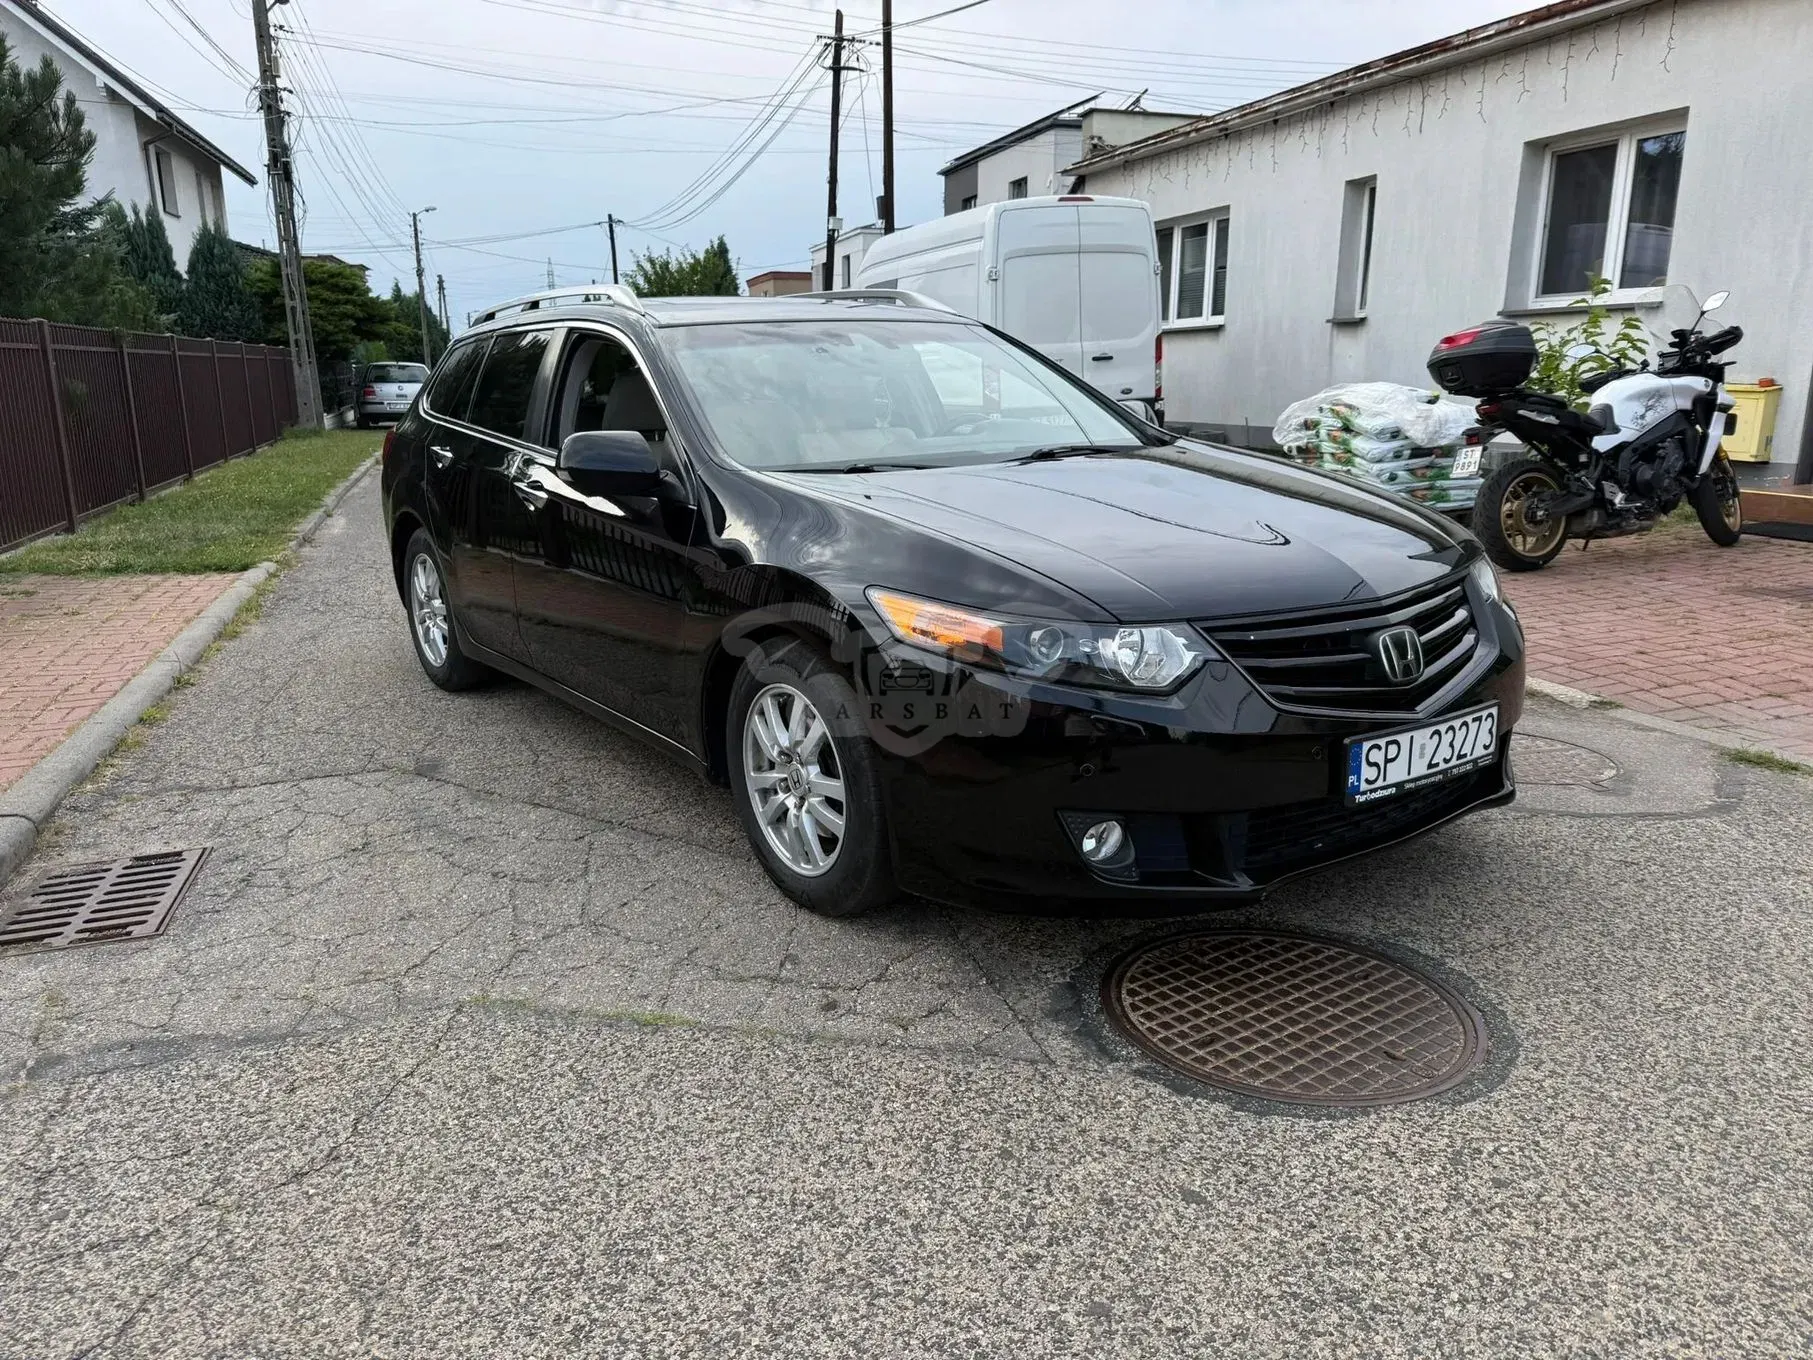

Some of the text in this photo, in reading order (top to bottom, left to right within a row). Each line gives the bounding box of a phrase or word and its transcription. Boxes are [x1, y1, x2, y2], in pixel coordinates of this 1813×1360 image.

[1463, 448, 1475, 459] ST
[1454, 460, 1477, 472] 9891
[1364, 712, 1495, 785] SPI 23273
[1348, 775, 1359, 788] PL
